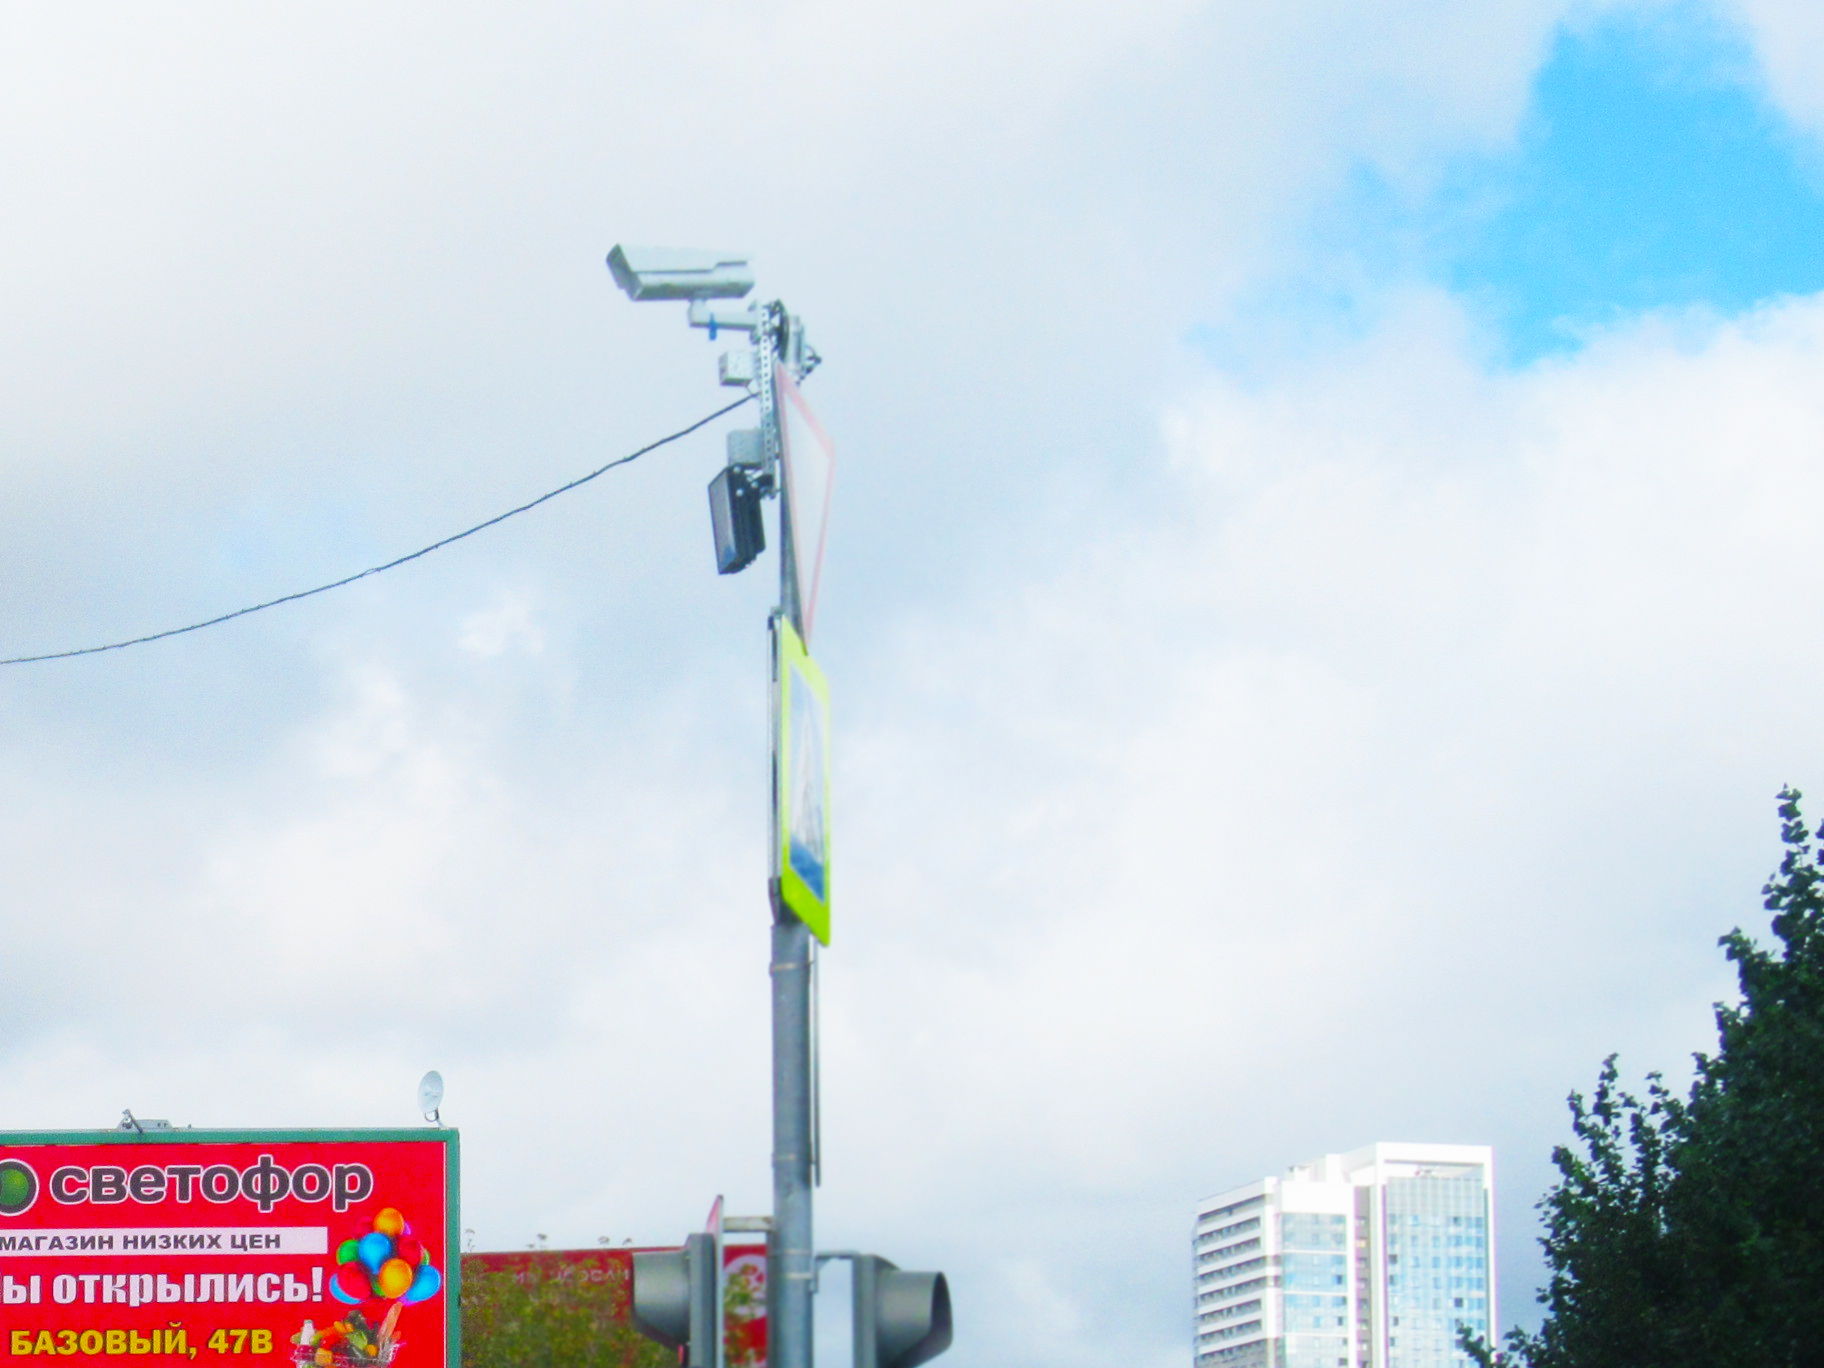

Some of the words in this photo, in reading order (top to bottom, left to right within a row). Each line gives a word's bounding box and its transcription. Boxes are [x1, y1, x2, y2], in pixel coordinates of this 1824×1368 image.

[49, 1154, 374, 1214] светофор
[122, 1234, 222, 1250] НИЗКИХ
[230, 1233, 281, 1252] ЦЕН
[52, 1266, 324, 1308] открылись!
[10, 1321, 197, 1360] БАЗОВЫЙ,
[207, 1328, 274, 1355] 47В
